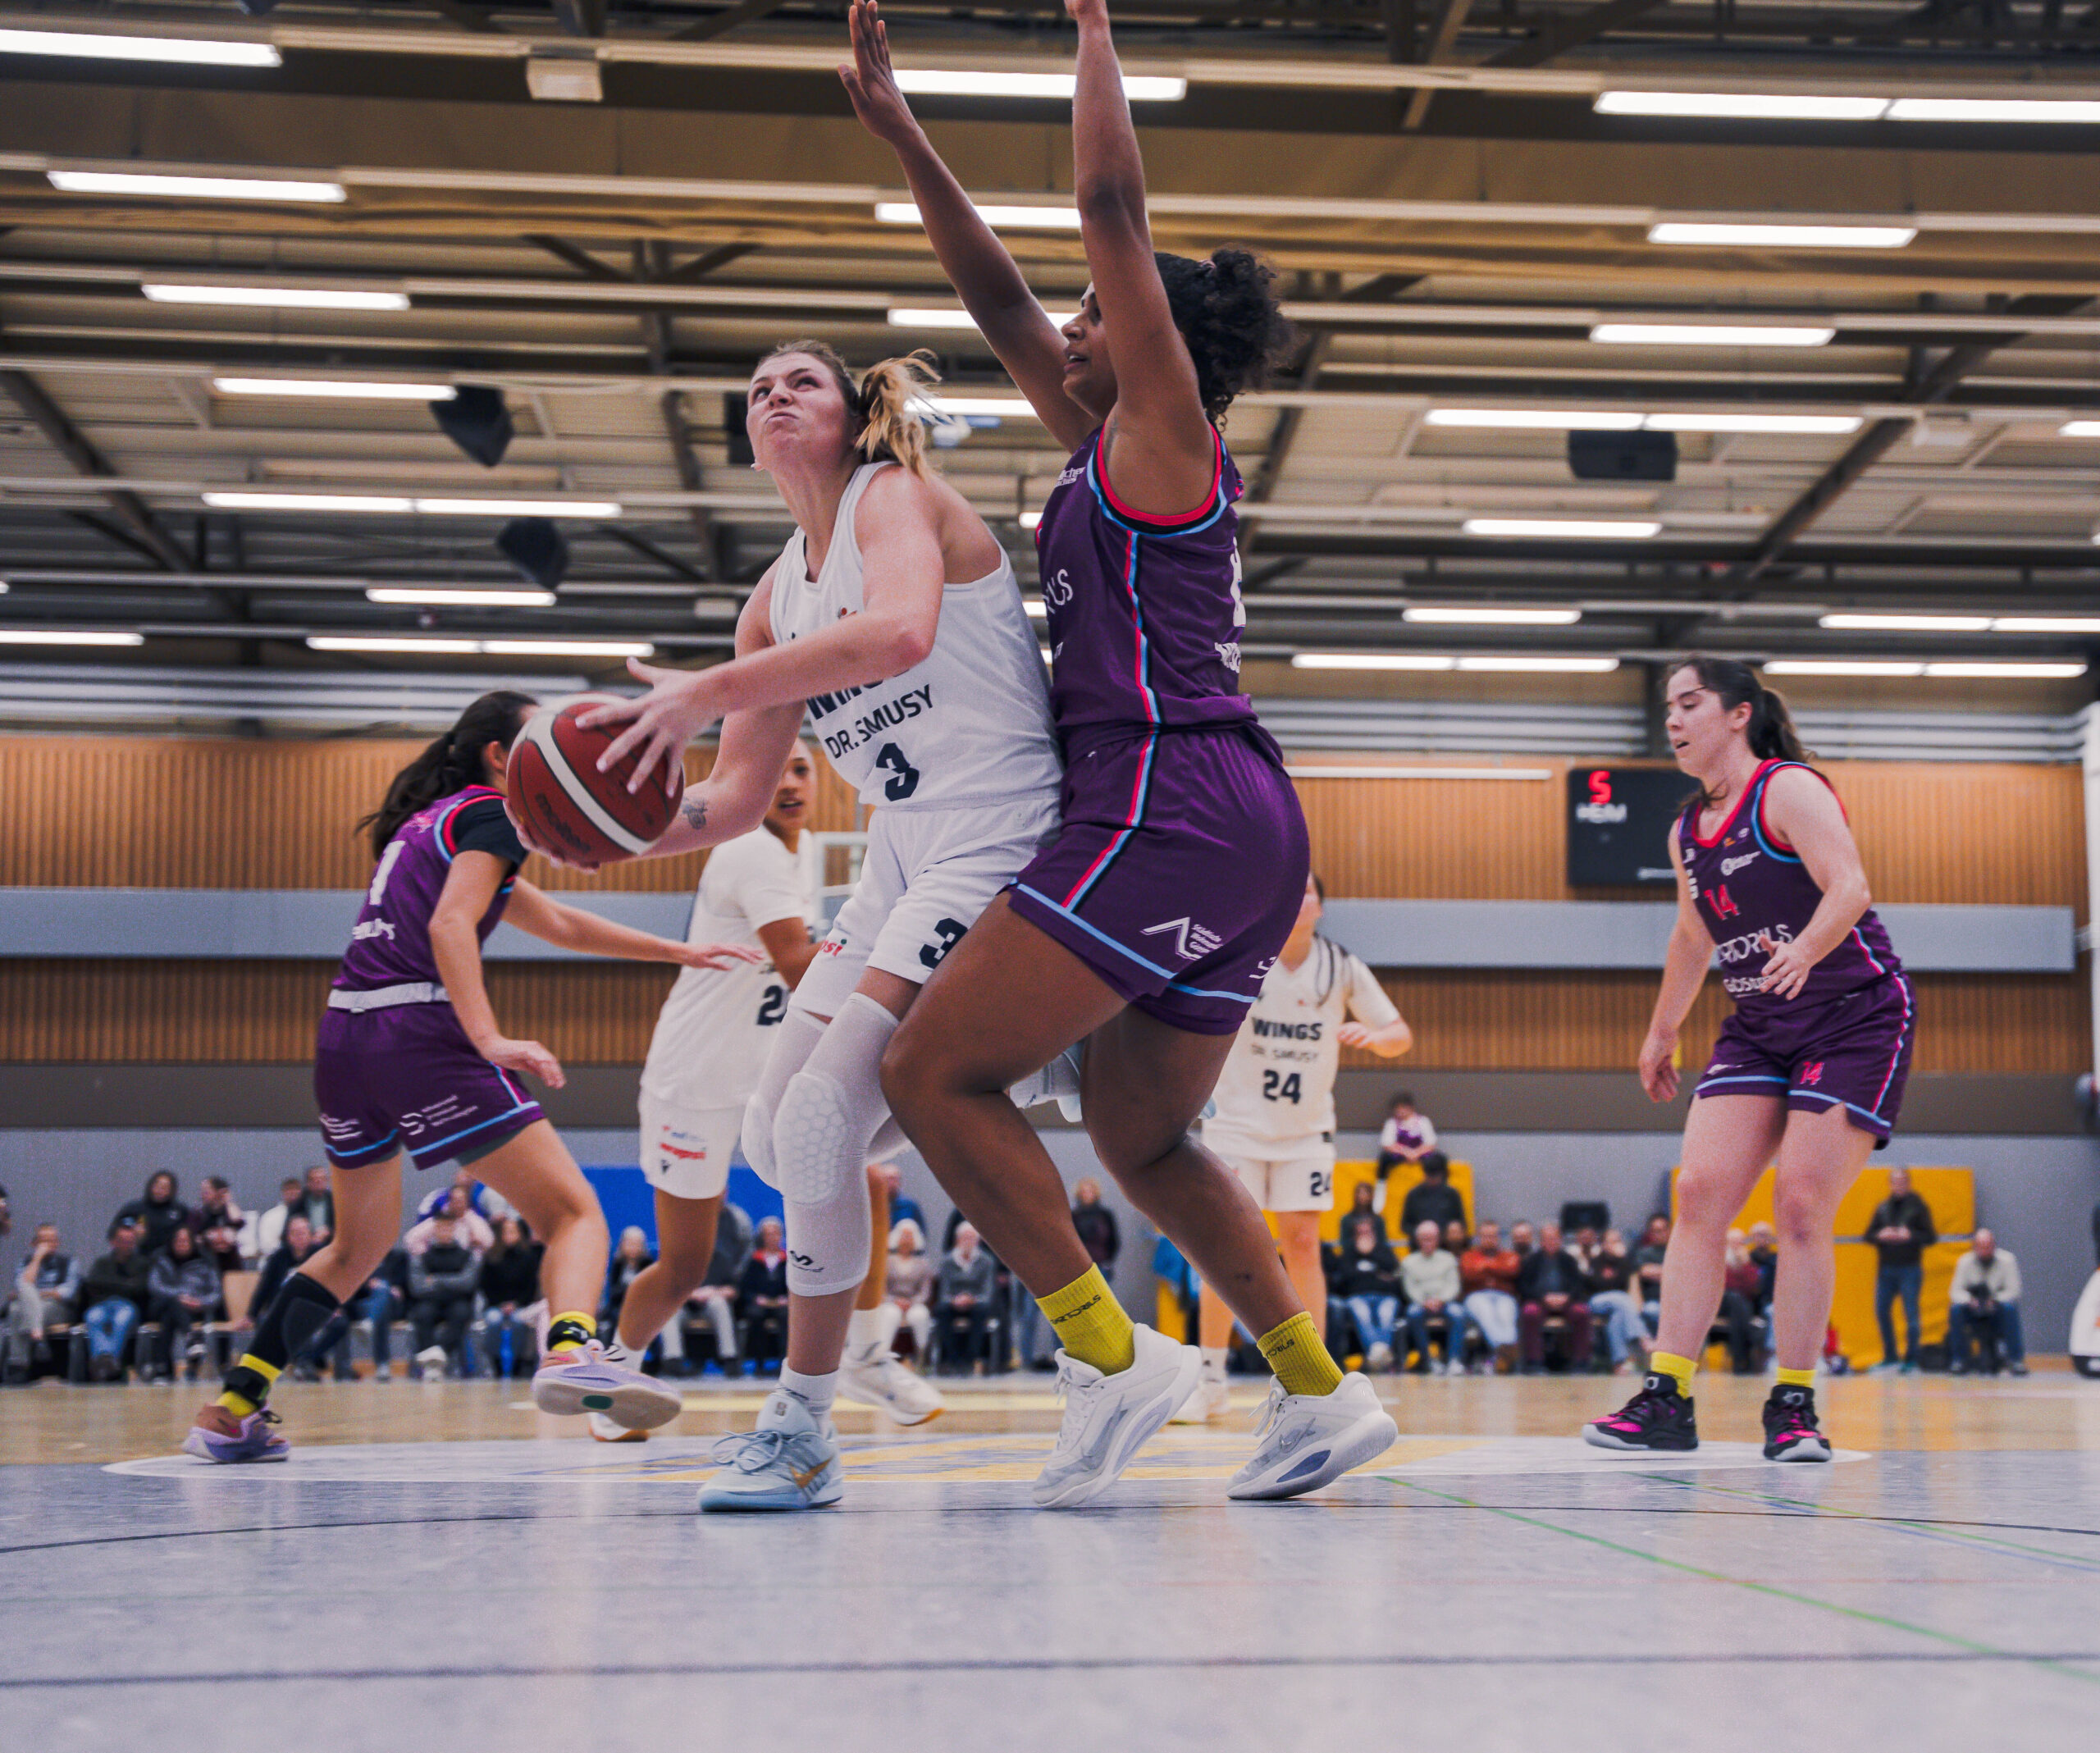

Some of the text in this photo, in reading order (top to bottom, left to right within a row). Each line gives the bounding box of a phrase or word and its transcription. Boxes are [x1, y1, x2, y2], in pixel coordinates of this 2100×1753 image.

[875, 742, 920, 802] 3
[369, 840, 406, 906] 1
[1704, 883, 1741, 920] 14
[919, 917, 969, 970] 3
[1252, 1017, 1322, 1042] WINGS
[1263, 1069, 1301, 1104] 24
[1800, 1061, 1825, 1085] 14
